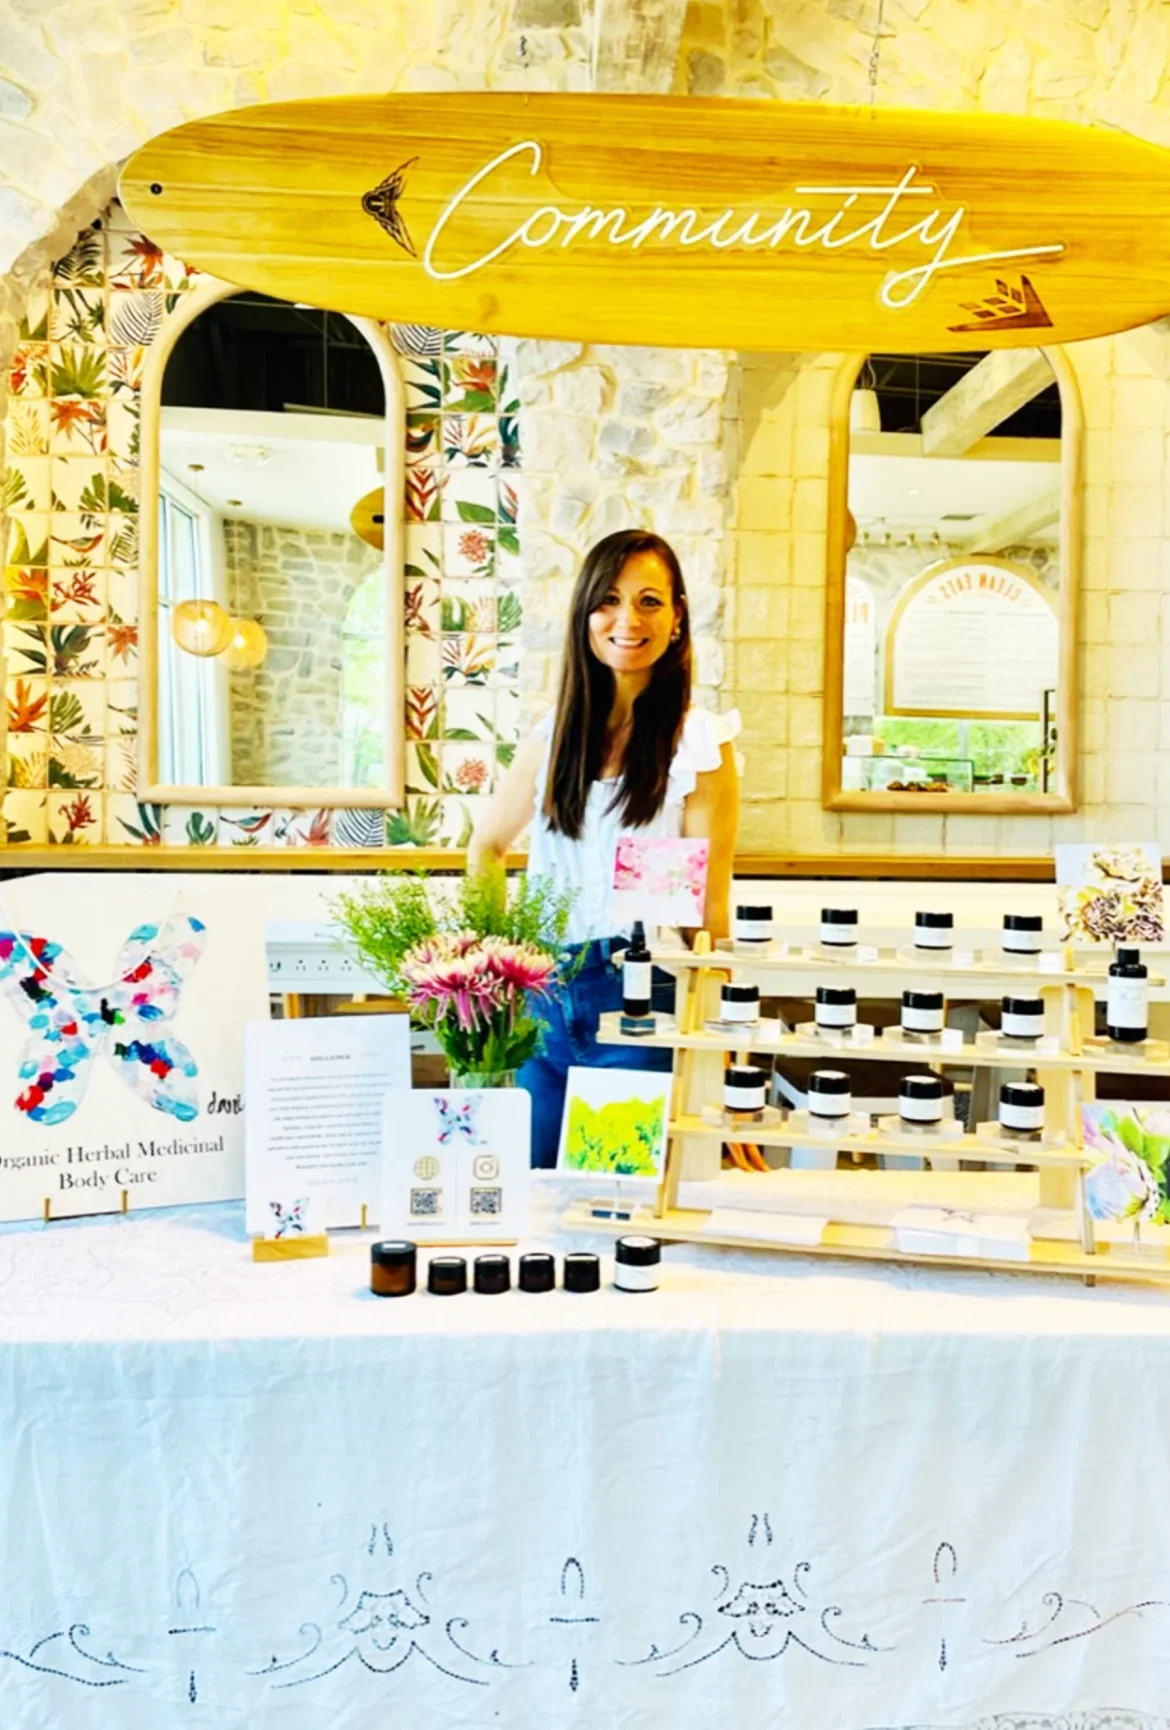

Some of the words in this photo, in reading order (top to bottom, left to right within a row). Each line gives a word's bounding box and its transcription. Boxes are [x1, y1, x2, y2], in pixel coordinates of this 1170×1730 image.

[424, 140, 1066, 308] Community
[67, 1143, 131, 1164] Herbal
[138, 1135, 225, 1158] Medicinal
[59, 1170, 109, 1191] Body
[114, 1167, 157, 1186] Care
